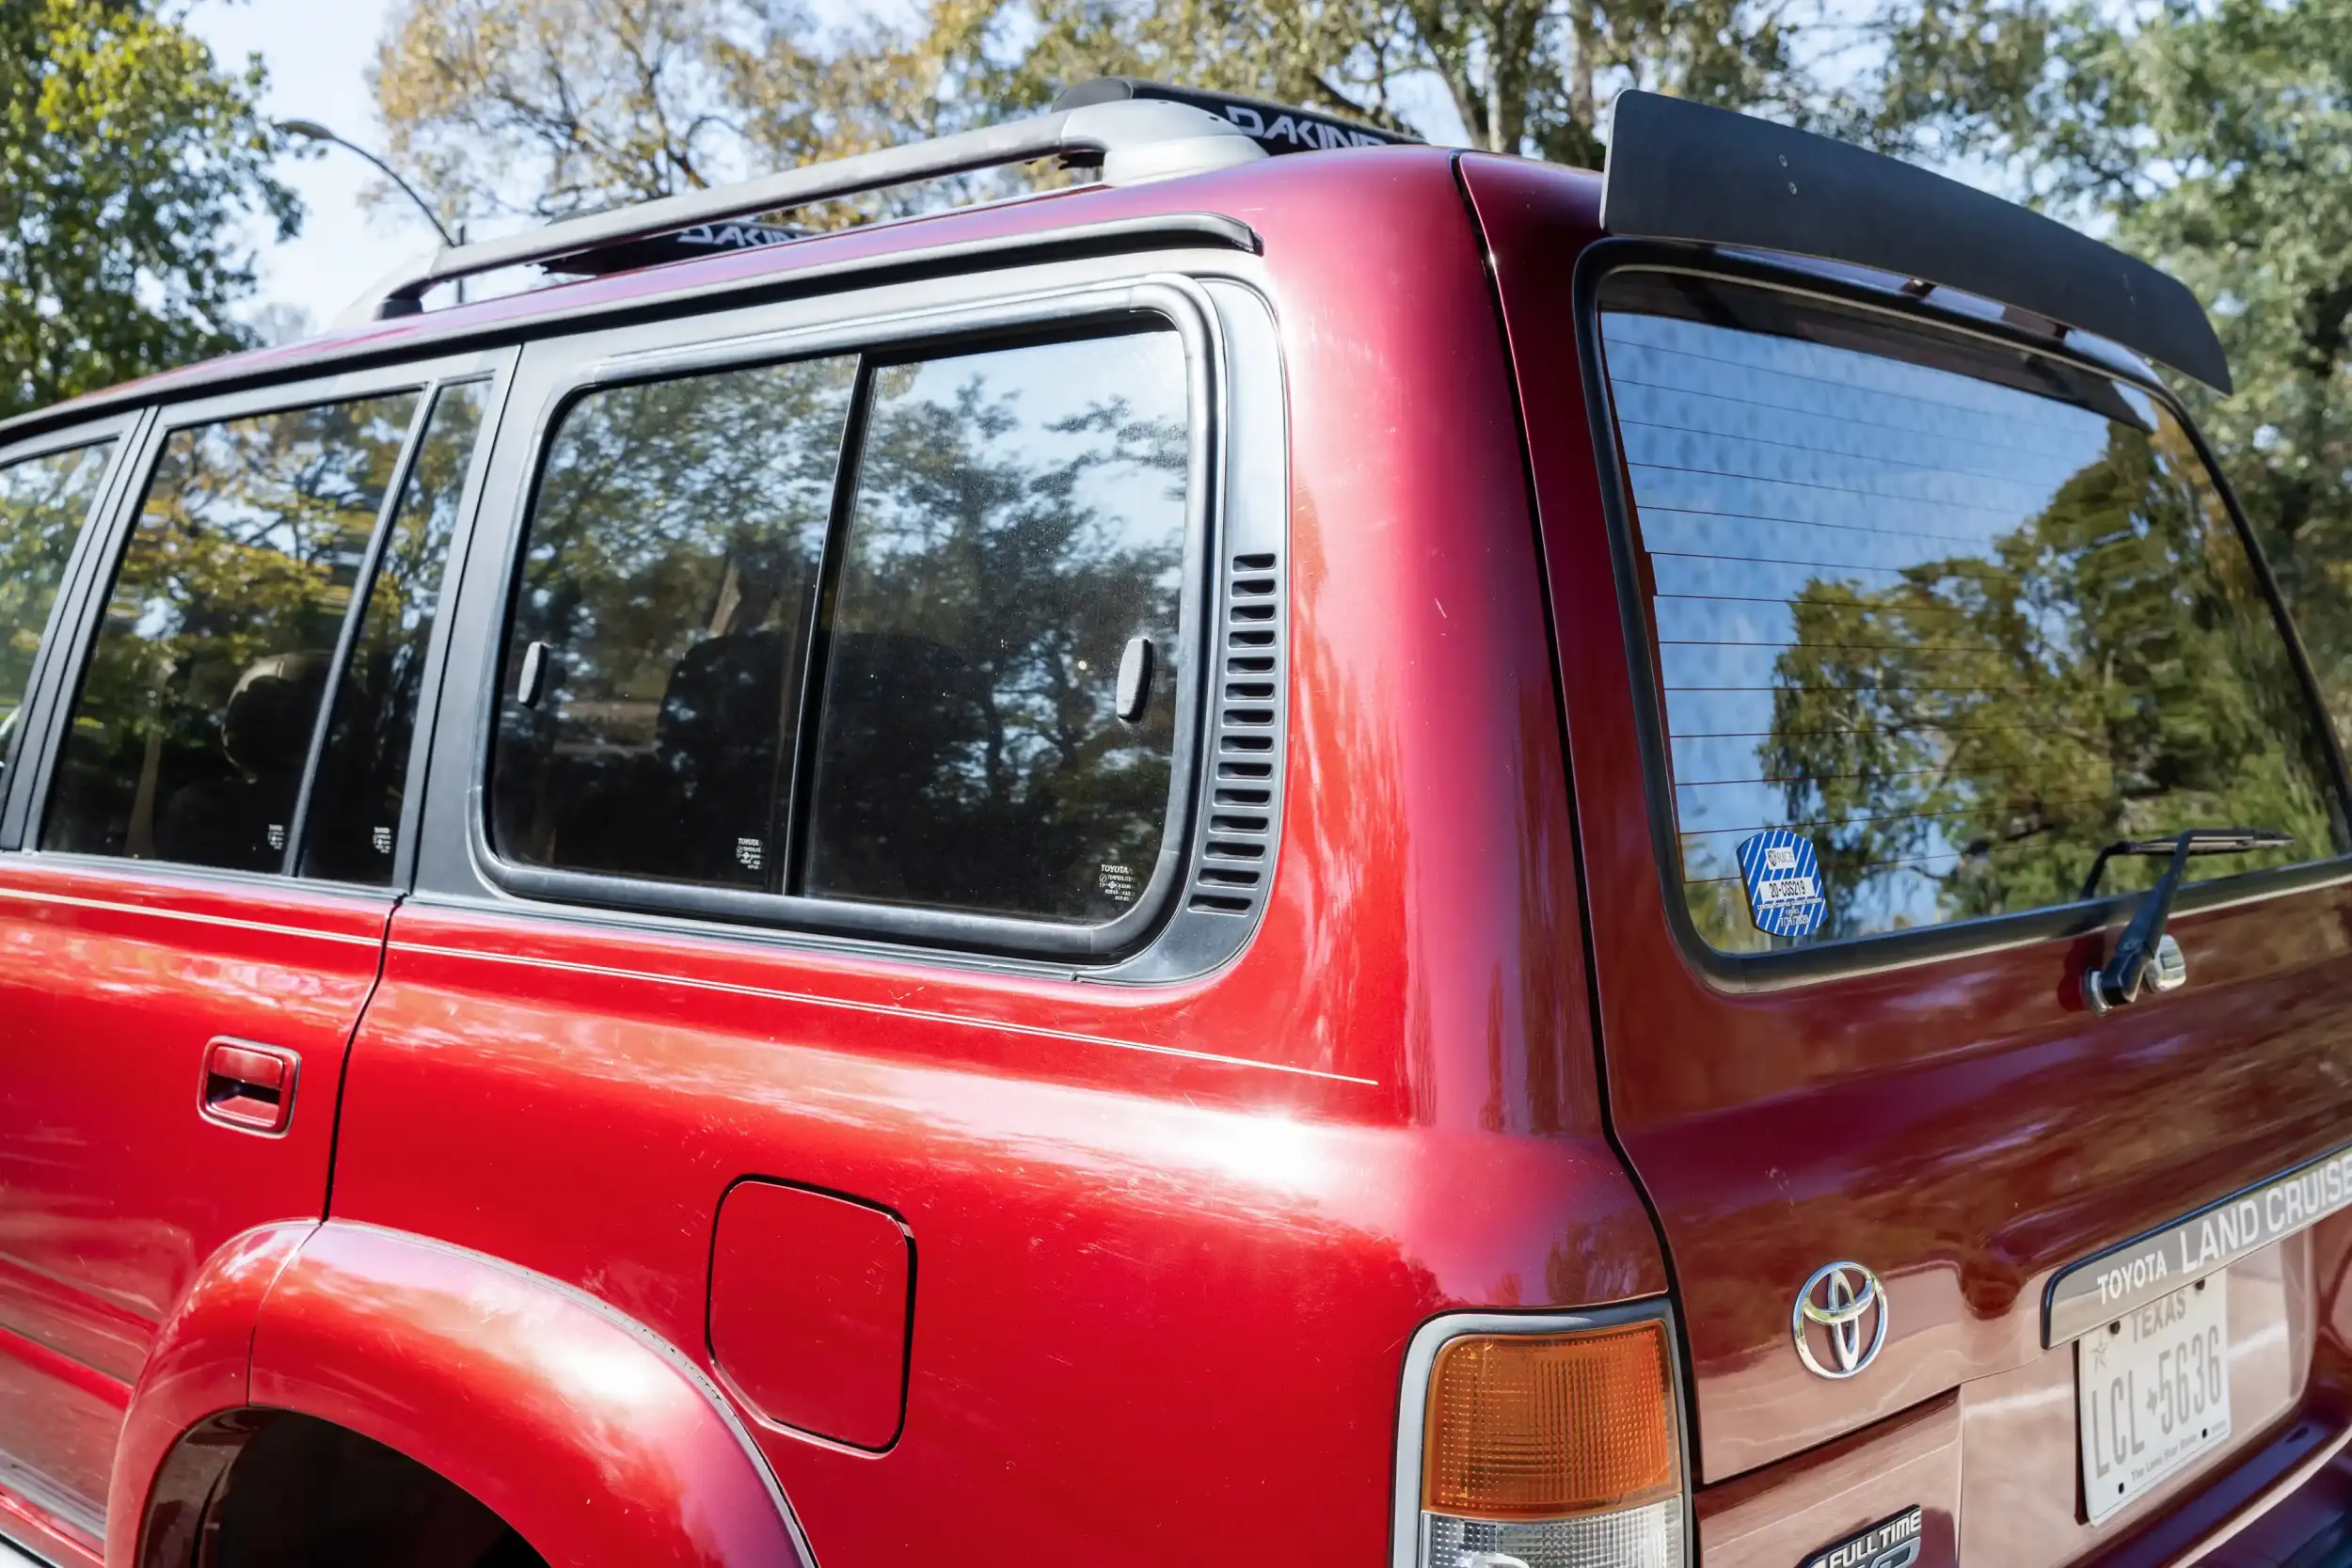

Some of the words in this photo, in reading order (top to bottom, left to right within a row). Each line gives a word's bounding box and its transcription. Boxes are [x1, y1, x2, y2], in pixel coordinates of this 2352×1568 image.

[1101, 864, 1129, 874] TOYOTA
[1776, 851, 1794, 863] RICE
[2096, 1250, 2168, 1306] TOYOTA
[2180, 1199, 2259, 1275] LAND
[2130, 1290, 2186, 1343] TEXAS
[2091, 1370, 2145, 1479] LCL
[2158, 1324, 2221, 1435] 5636
[1829, 1536, 1878, 1568] FULL
[1879, 1510, 1921, 1548] TIME
